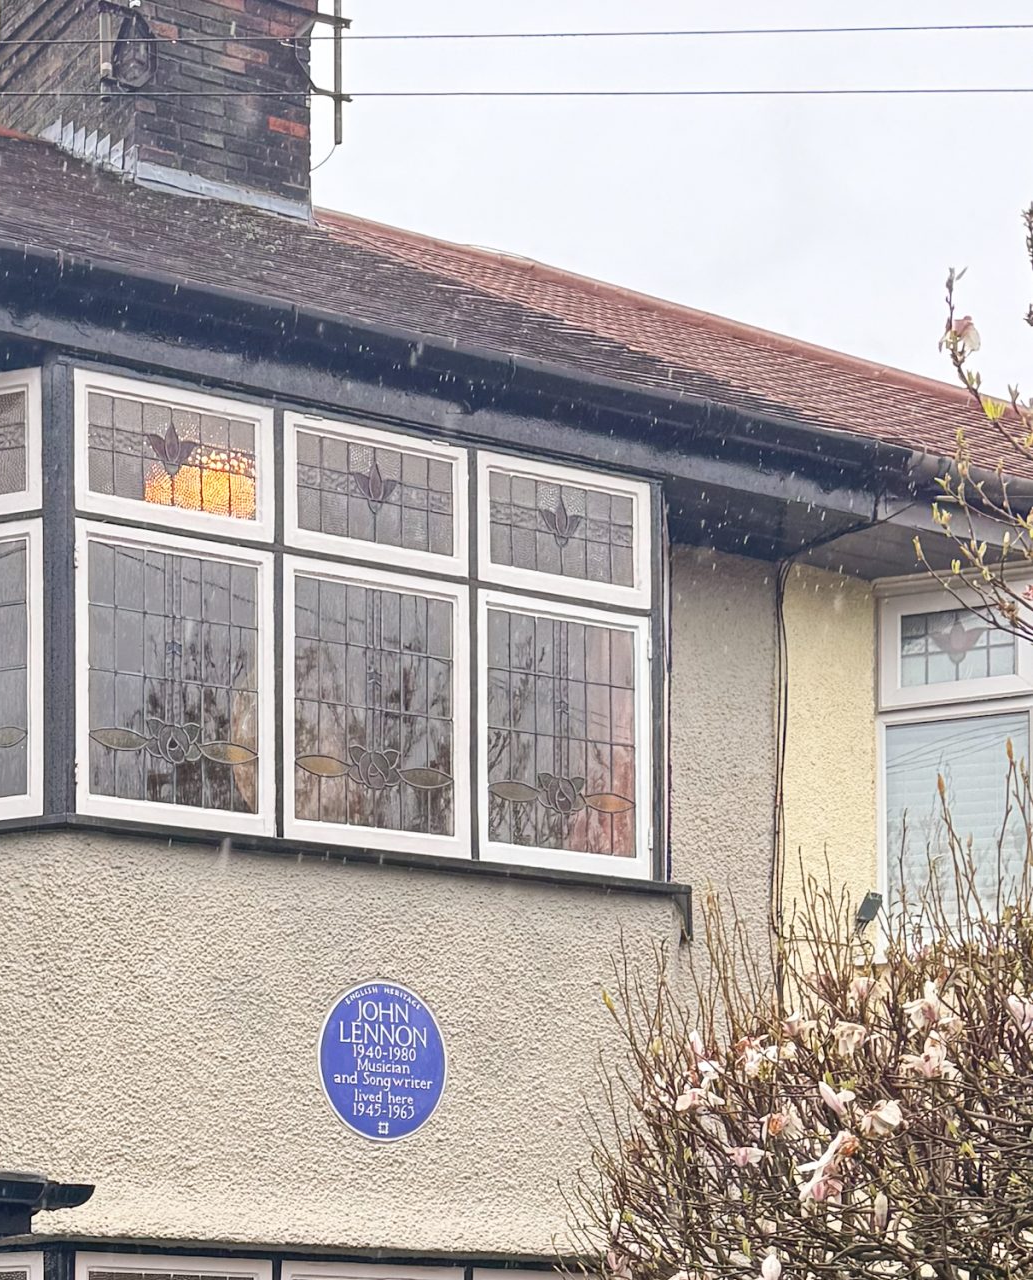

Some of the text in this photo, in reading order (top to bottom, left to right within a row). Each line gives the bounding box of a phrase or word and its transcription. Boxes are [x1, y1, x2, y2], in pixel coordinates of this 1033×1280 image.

[345, 986, 422, 1010] ENGLISH HERITAGE
[357, 1000, 409, 1023] JOHN
[339, 1021, 427, 1048] LENNON
[353, 1044, 416, 1061] 1940-1980
[357, 1058, 410, 1074] Musician
[334, 1072, 358, 1084] and
[354, 1089, 414, 1105] lived here
[353, 1102, 415, 1119] 1945-1963
